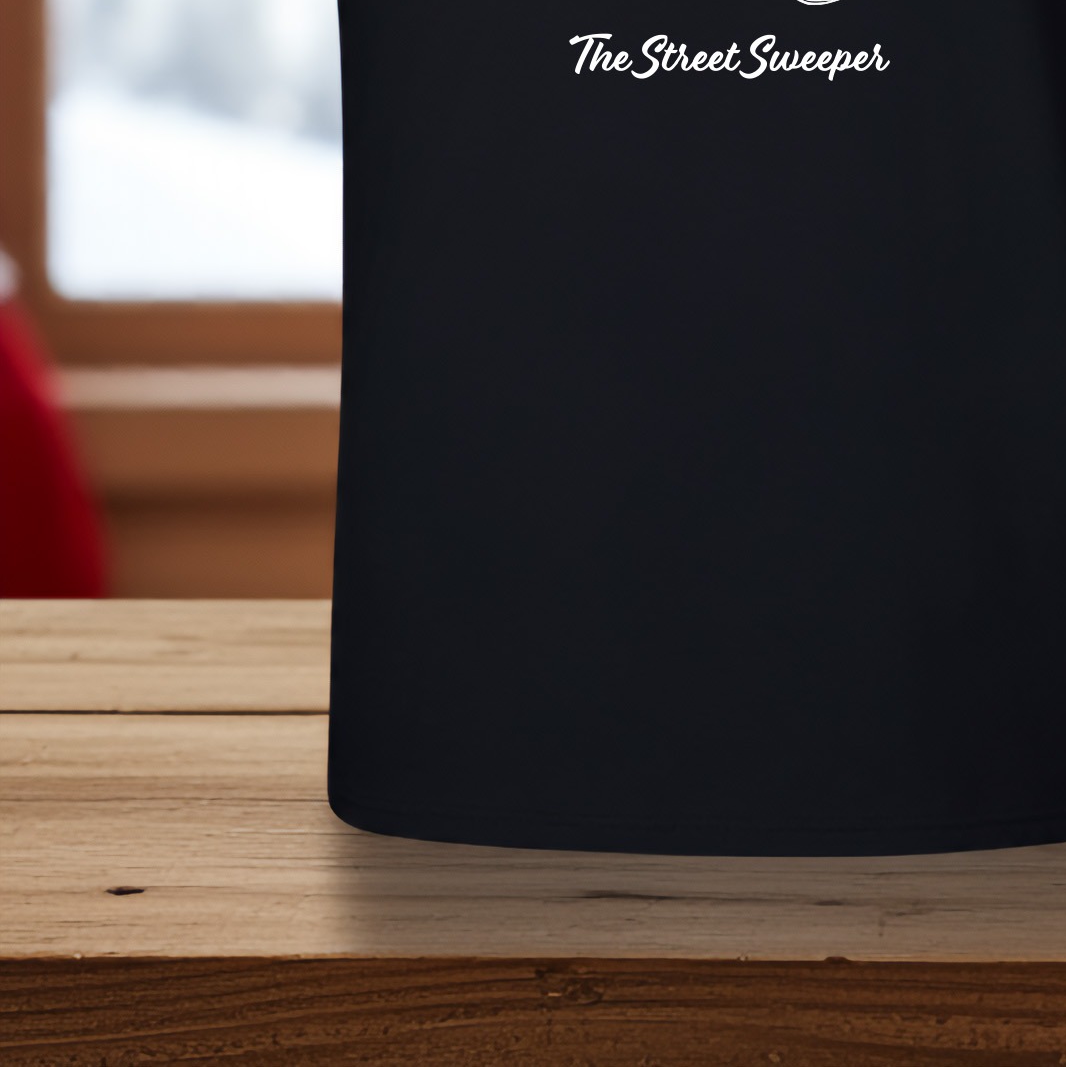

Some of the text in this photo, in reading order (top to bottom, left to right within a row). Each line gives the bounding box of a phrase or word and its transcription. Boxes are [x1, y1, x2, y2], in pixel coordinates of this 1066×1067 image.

[568, 33, 891, 82] The Street Sweeper
